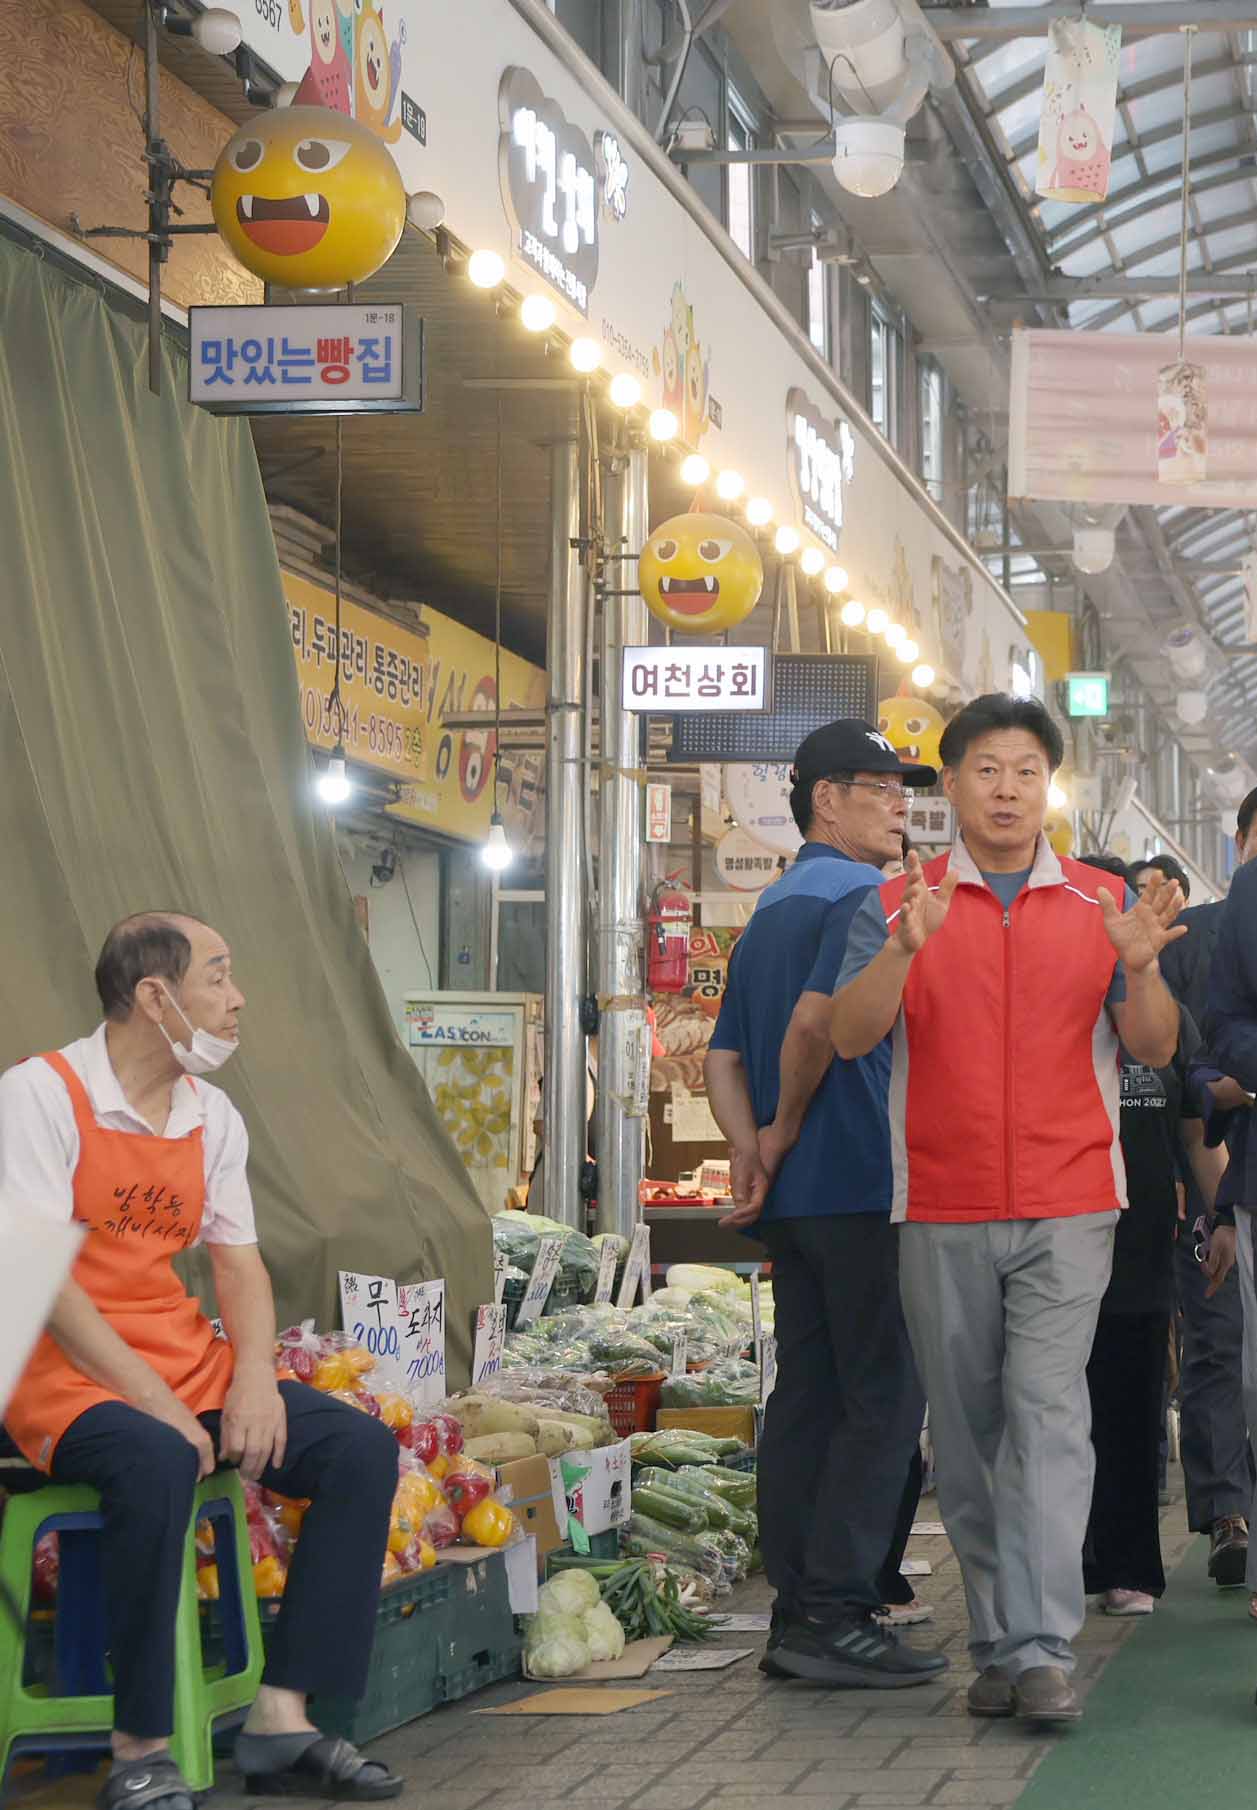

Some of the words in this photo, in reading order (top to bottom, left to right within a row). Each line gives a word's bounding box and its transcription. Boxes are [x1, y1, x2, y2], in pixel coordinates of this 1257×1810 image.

[201, 336, 393, 385] 맛있는빵집
[632, 664, 757, 697] 여천상회
[367, 1280, 389, 1329] 무
